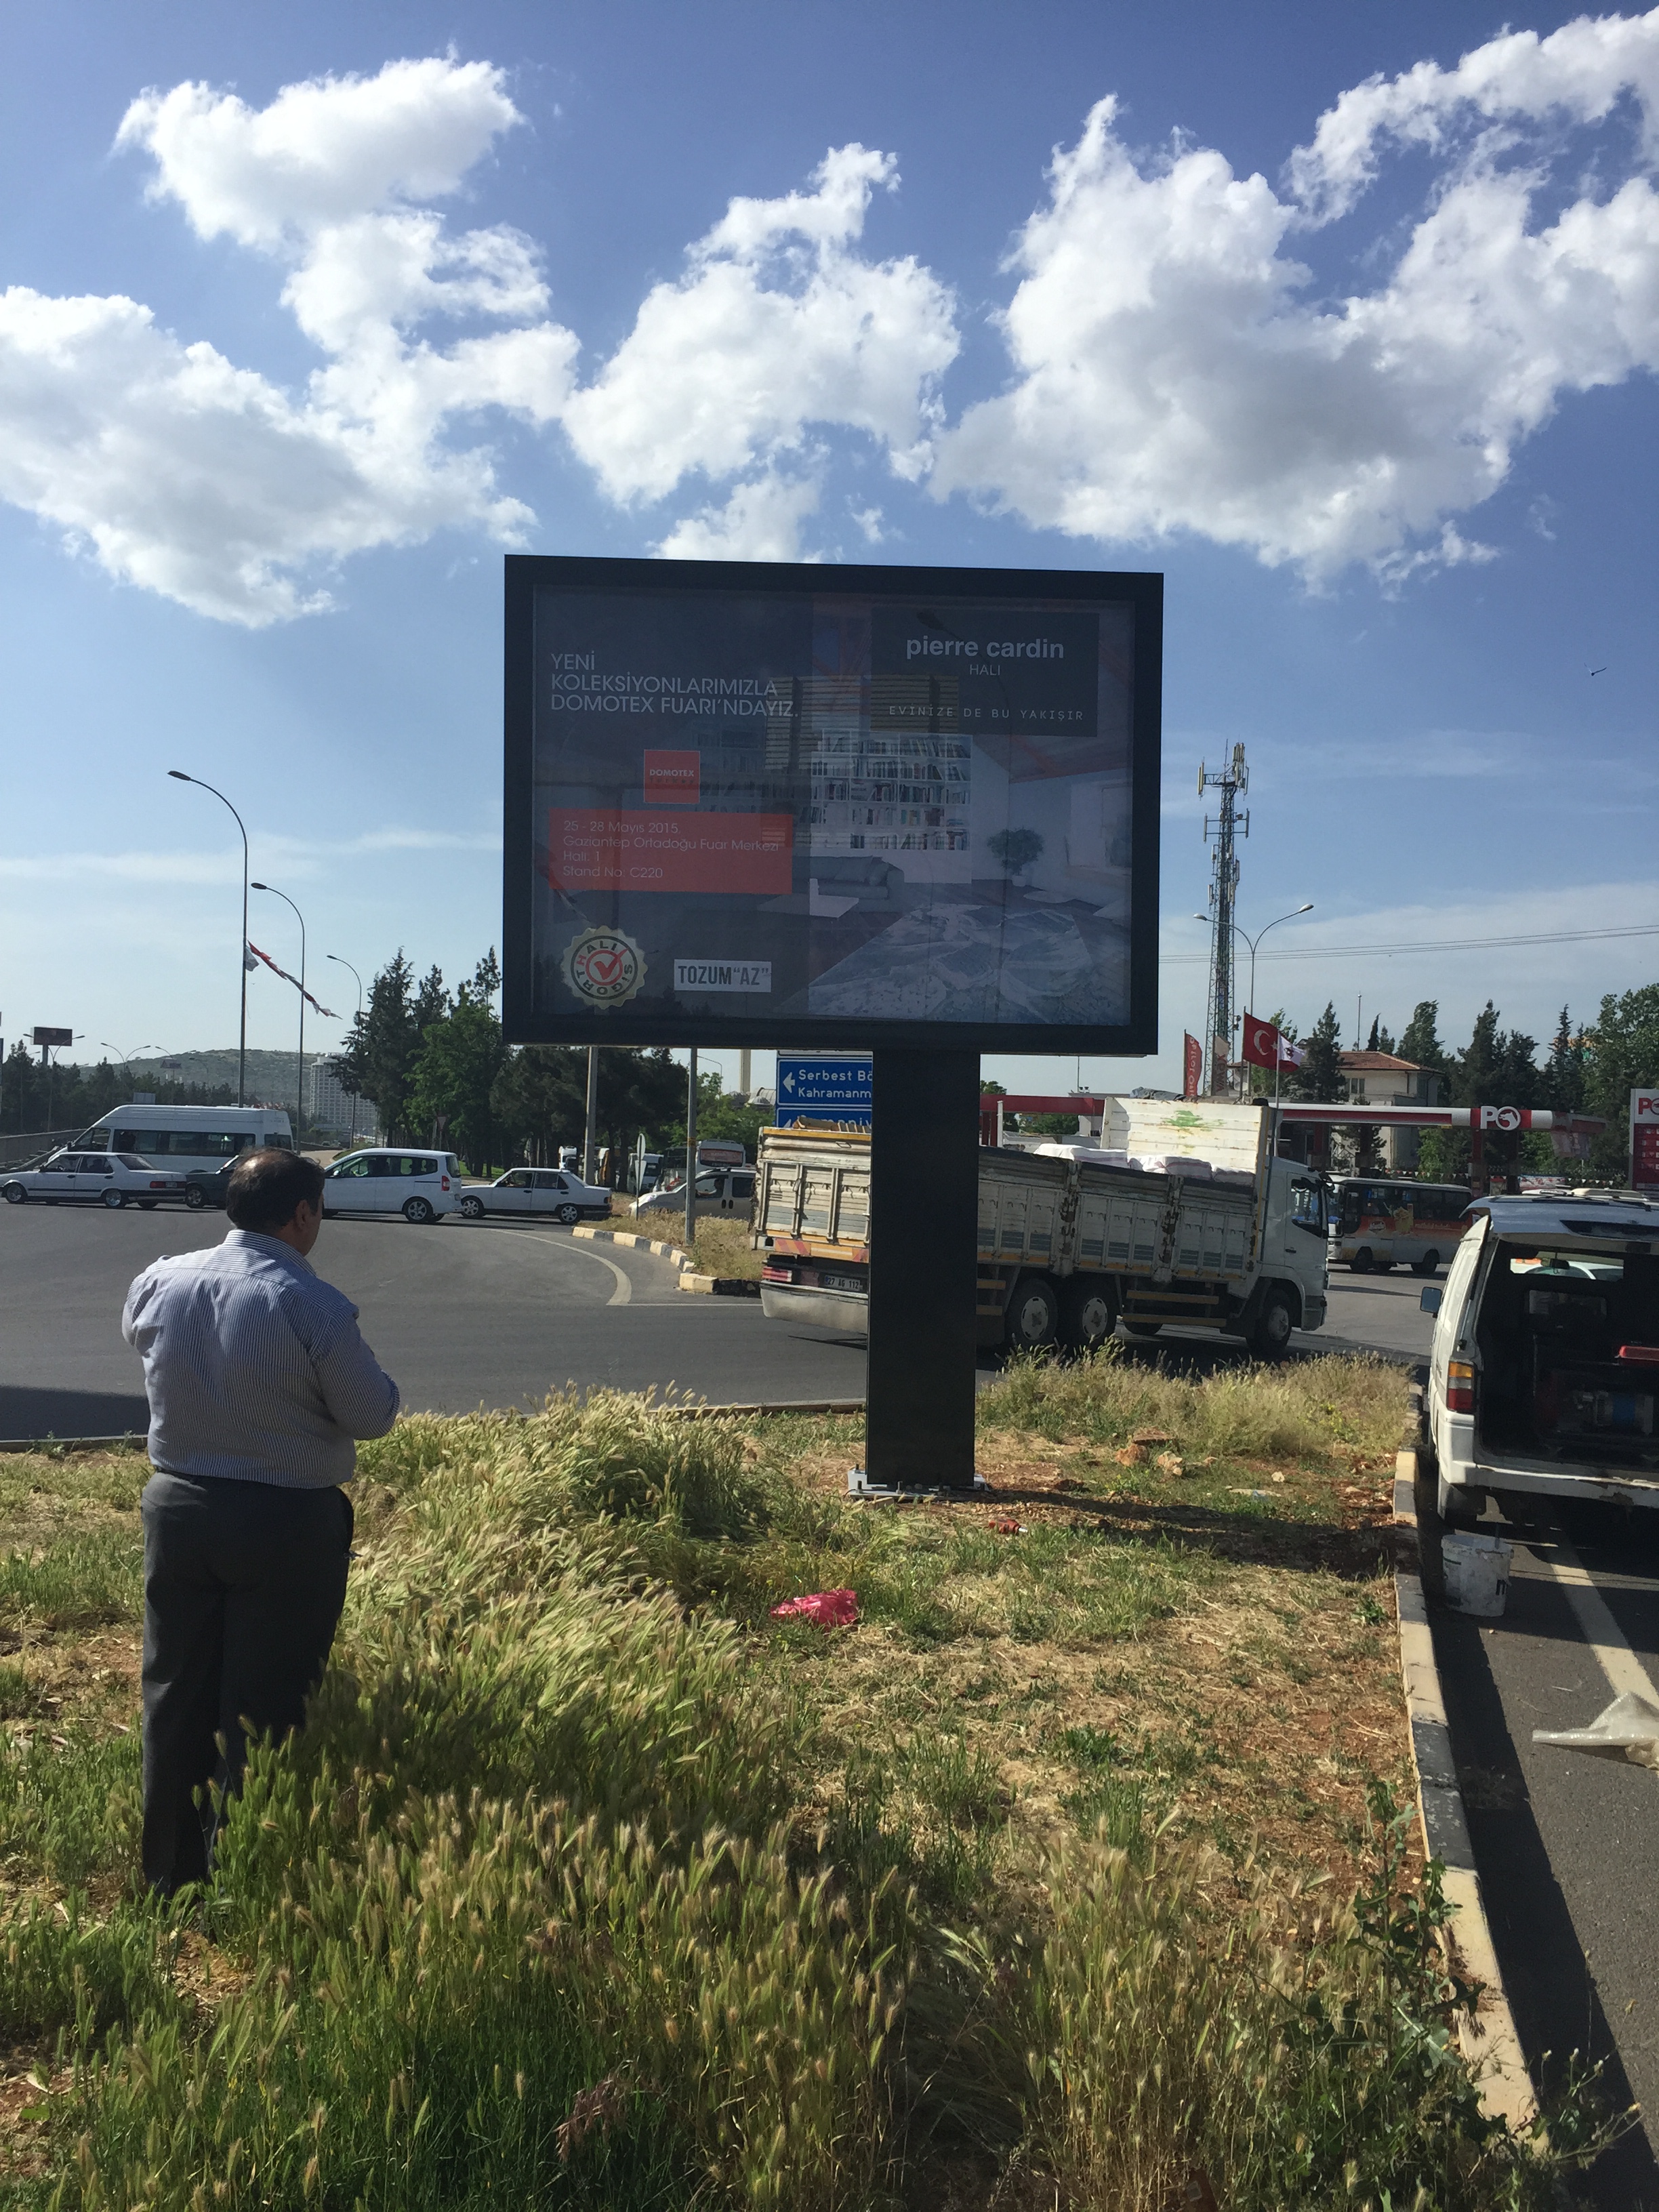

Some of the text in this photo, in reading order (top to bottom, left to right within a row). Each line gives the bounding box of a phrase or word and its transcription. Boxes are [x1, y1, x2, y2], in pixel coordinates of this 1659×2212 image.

[907, 635, 1064, 659] pierre cardin
[551, 651, 595, 670] YENİ
[969, 664, 1001, 676] HALI
[551, 672, 779, 696] KOLEKSİYONLARIMIZLA
[551, 695, 655, 714] DOMOTEX
[888, 703, 1084, 722] EVİNİZE DE BU YAKIŞIR
[649, 769, 695, 777] DOMOTEX
[563, 821, 579, 832] 25
[590, 821, 605, 832] 28
[609, 821, 644, 834] Mayıs
[563, 836, 630, 849] Gaziantep
[634, 837, 697, 852] Ortadoğu
[700, 839, 729, 851] Fuar
[595, 851, 600, 862] 1
[563, 865, 663, 879] Stand No: C220
[798, 1069, 853, 1081] Serbest
[798, 1087, 872, 1099] Kahramanm
